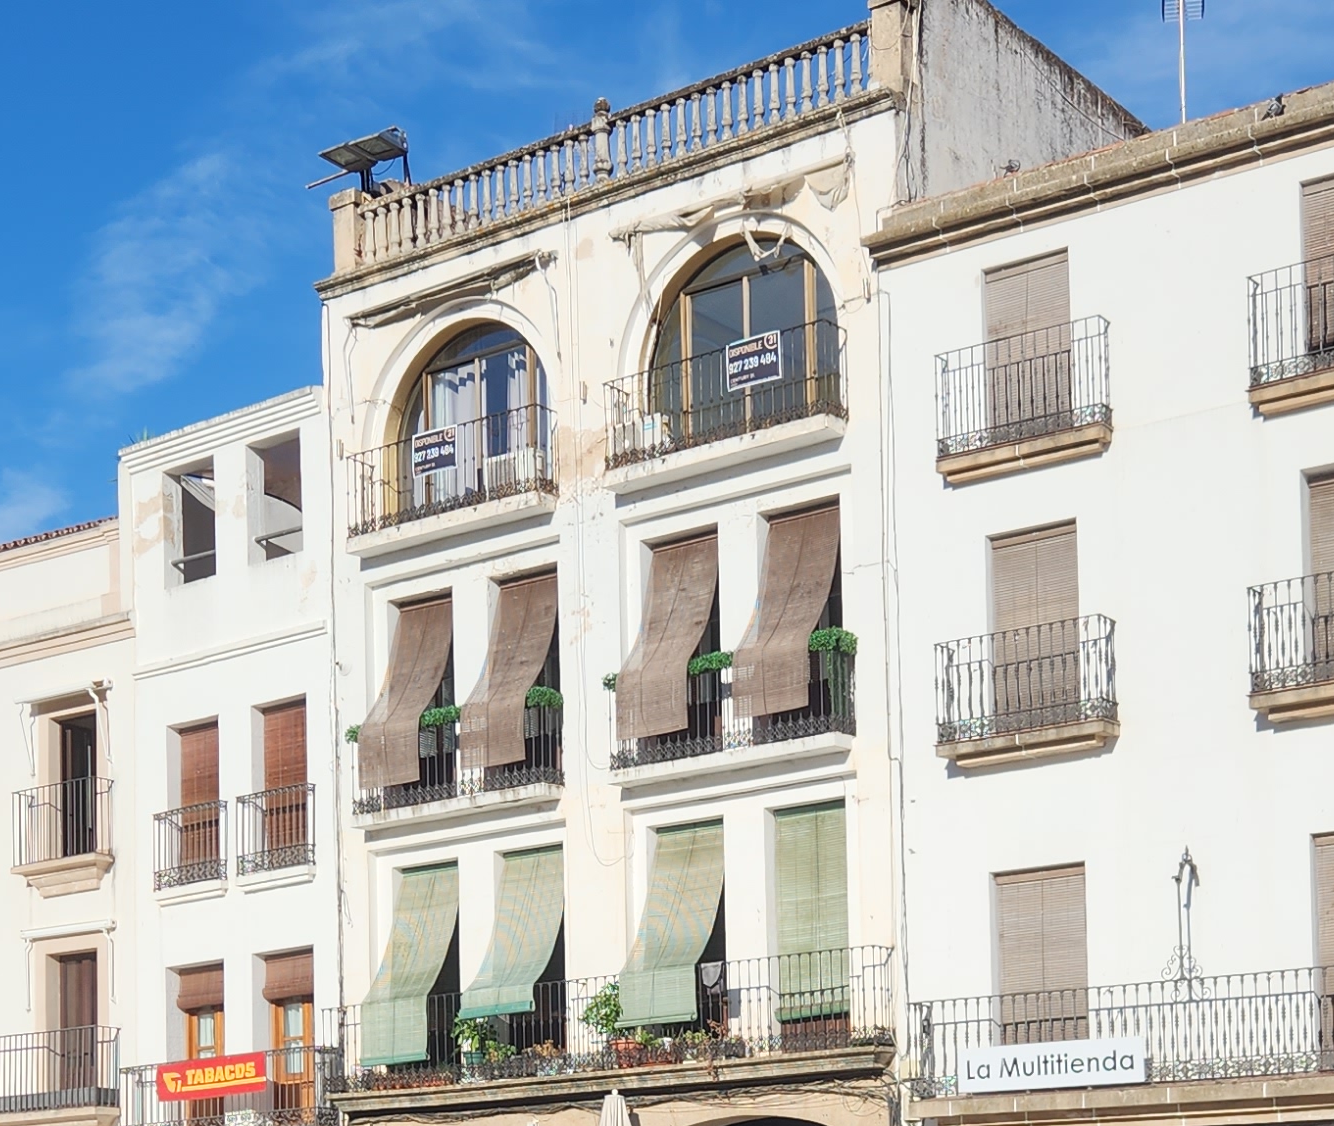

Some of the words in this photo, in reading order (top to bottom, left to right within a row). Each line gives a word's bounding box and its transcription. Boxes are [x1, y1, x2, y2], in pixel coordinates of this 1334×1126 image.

[729, 340, 763, 358] DISPONIBLE
[728, 360, 743, 375] 927
[744, 355, 759, 370] 239
[414, 433, 443, 448] DISPONIBLE
[414, 450, 426, 463] 927
[185, 1061, 256, 1085] TABACOS
[966, 1060, 991, 1080] La
[999, 1049, 1135, 1079] Multitienda
